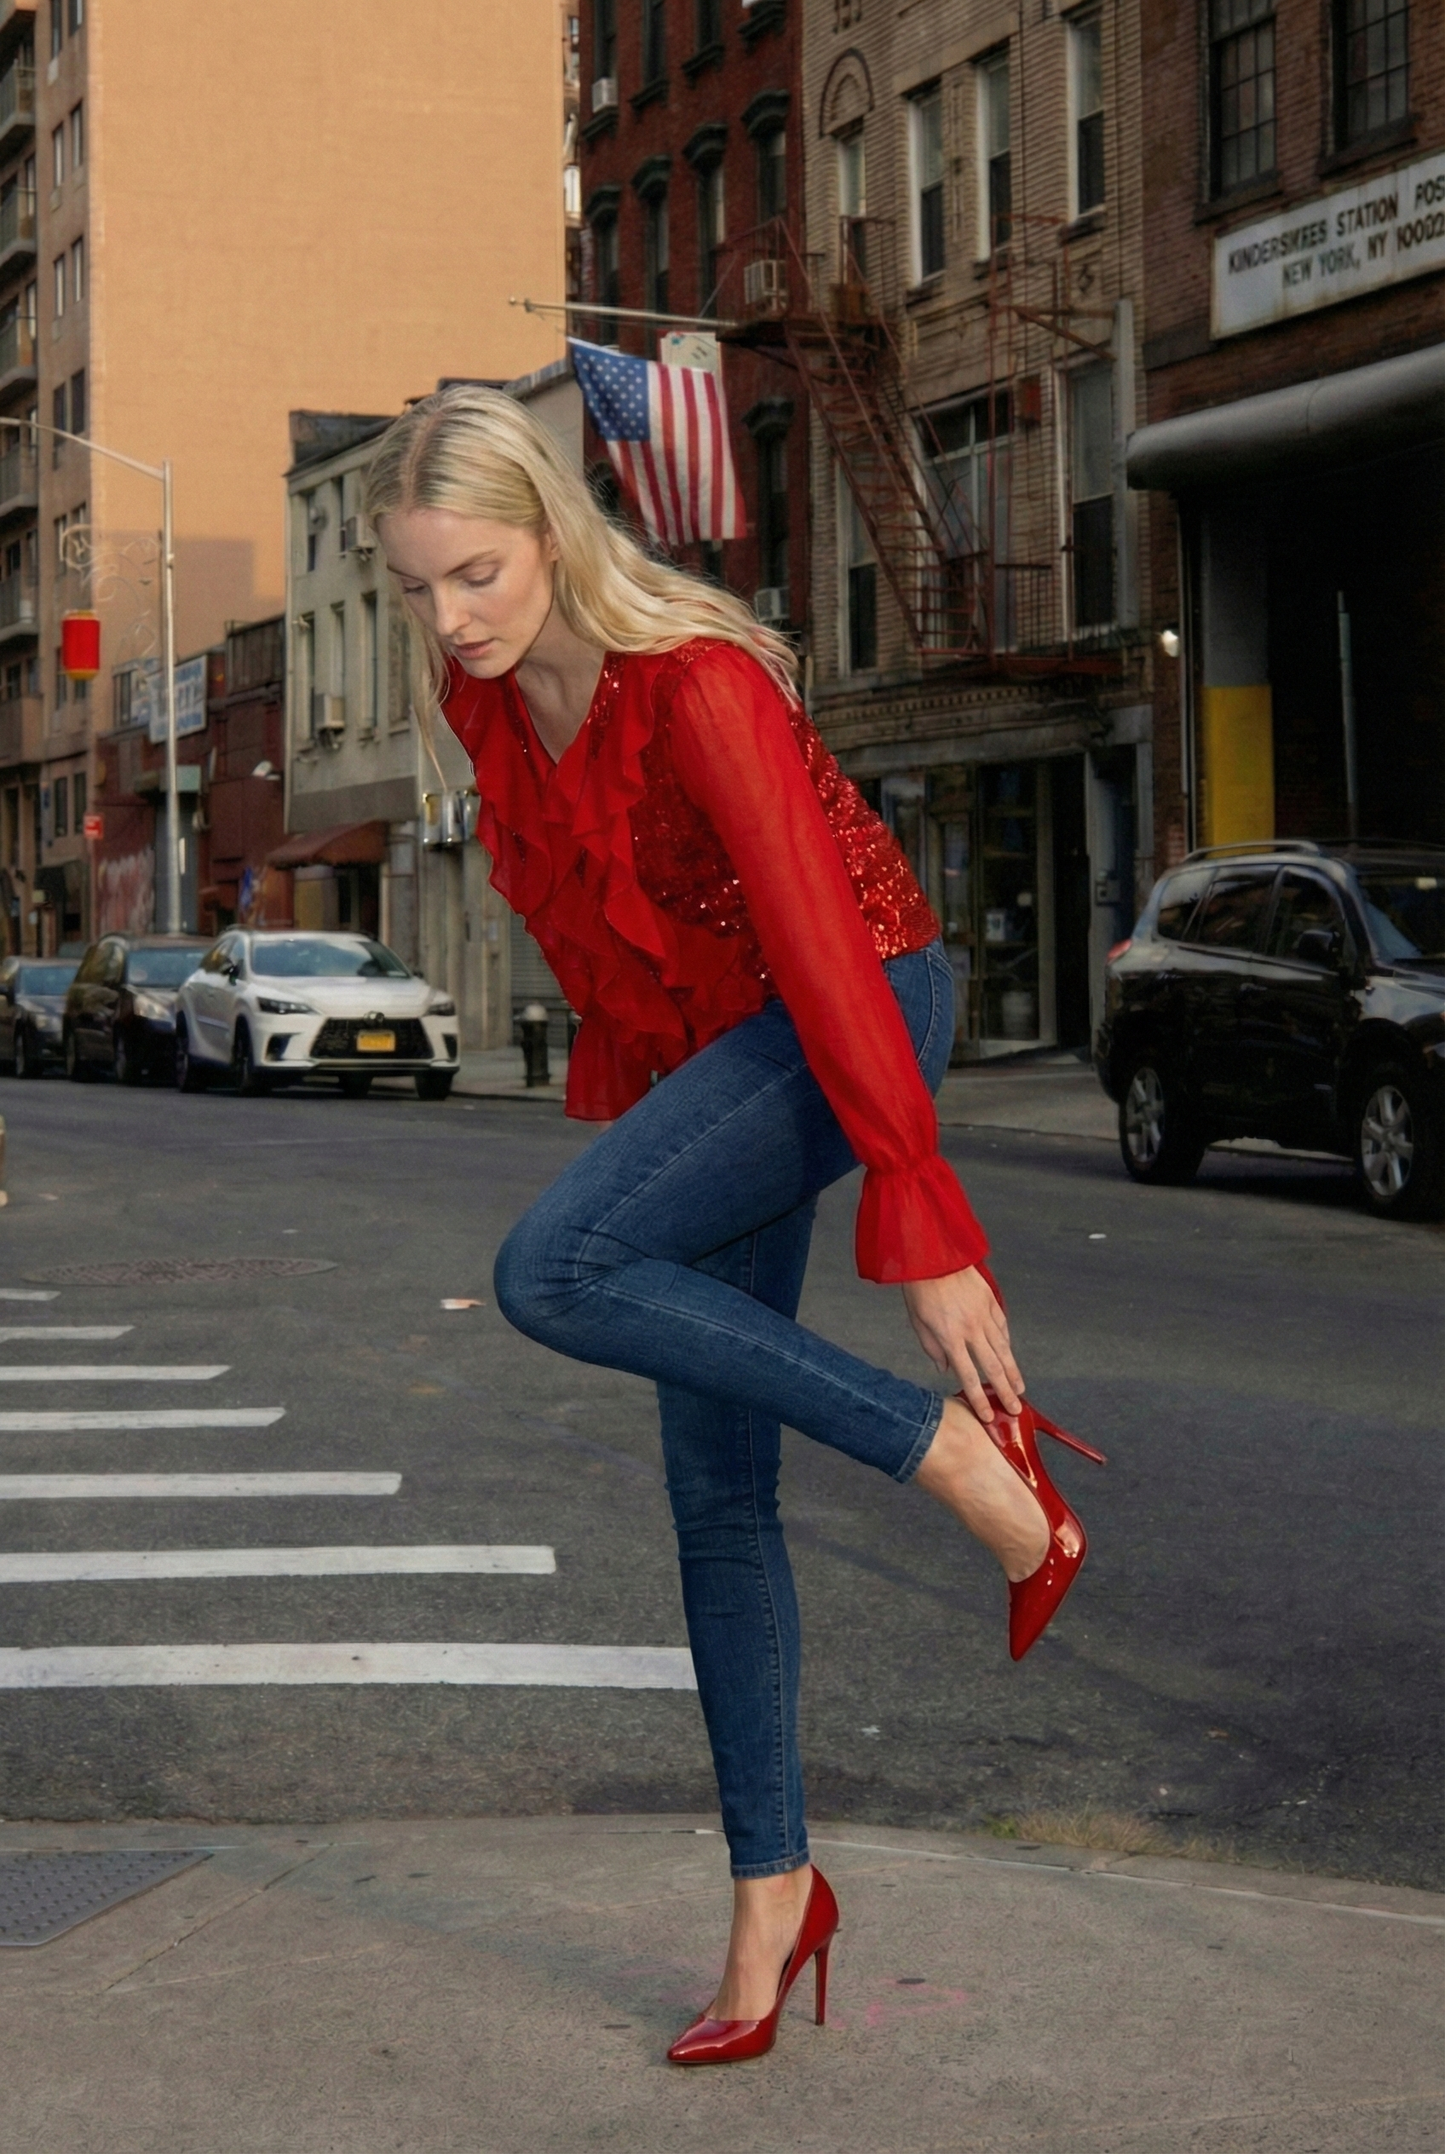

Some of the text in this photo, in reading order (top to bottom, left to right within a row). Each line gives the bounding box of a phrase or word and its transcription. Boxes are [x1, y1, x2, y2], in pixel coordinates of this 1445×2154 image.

[1336, 192, 1399, 238] STATION
[1282, 256, 1314, 289] NEW
[1318, 242, 1361, 278] YORK,
[1367, 230, 1389, 261] NY
